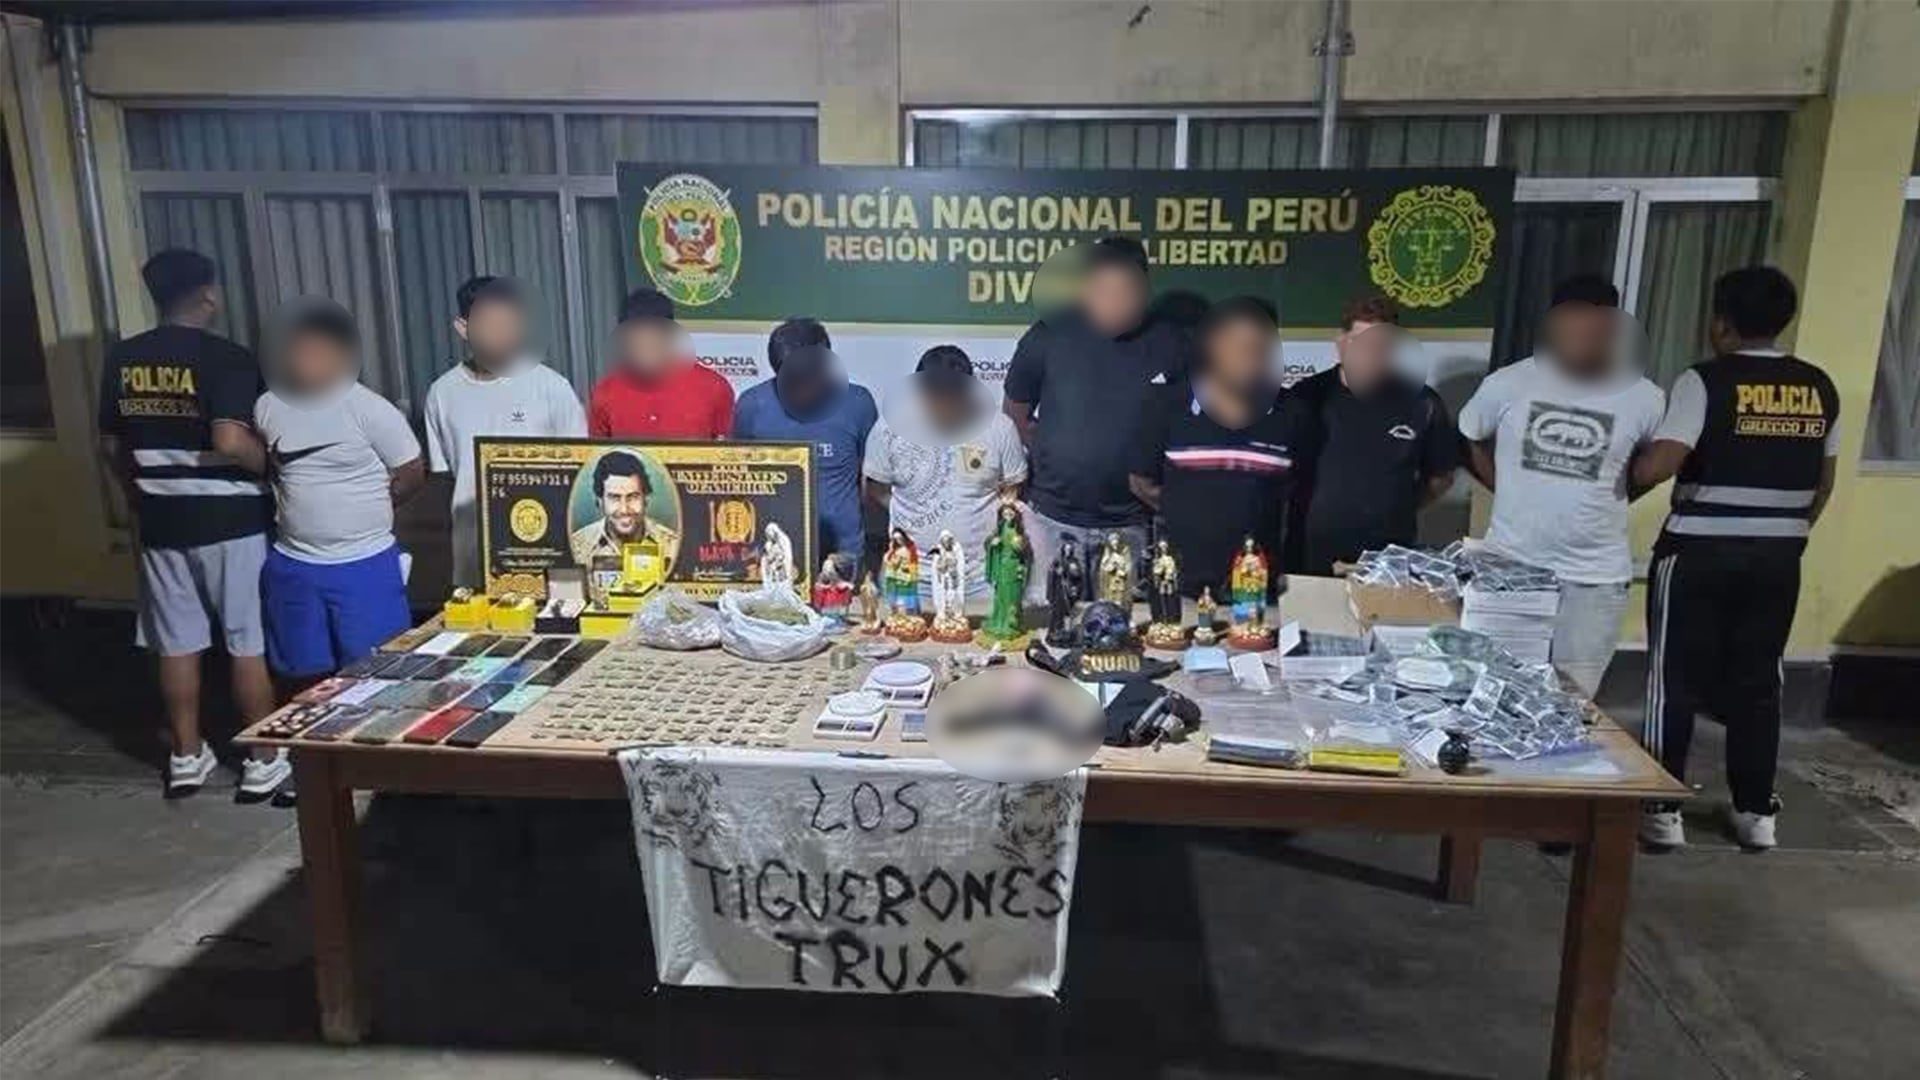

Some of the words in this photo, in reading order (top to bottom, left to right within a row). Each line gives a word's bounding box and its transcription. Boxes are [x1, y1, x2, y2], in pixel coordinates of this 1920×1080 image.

[757, 186, 919, 229] POLICÍA
[932, 195, 1142, 231] NACIONAL
[1155, 198, 1233, 231] DEL
[1246, 189, 1358, 231] PERÚ
[825, 231, 938, 262] REGIÓN
[1142, 239, 1288, 265] LIBERTAD
[968, 271, 1036, 303] DIV
[1081, 654, 1141, 675] SQUAD
[810, 776, 918, 832] LOS
[773, 929, 968, 992] TRUX
